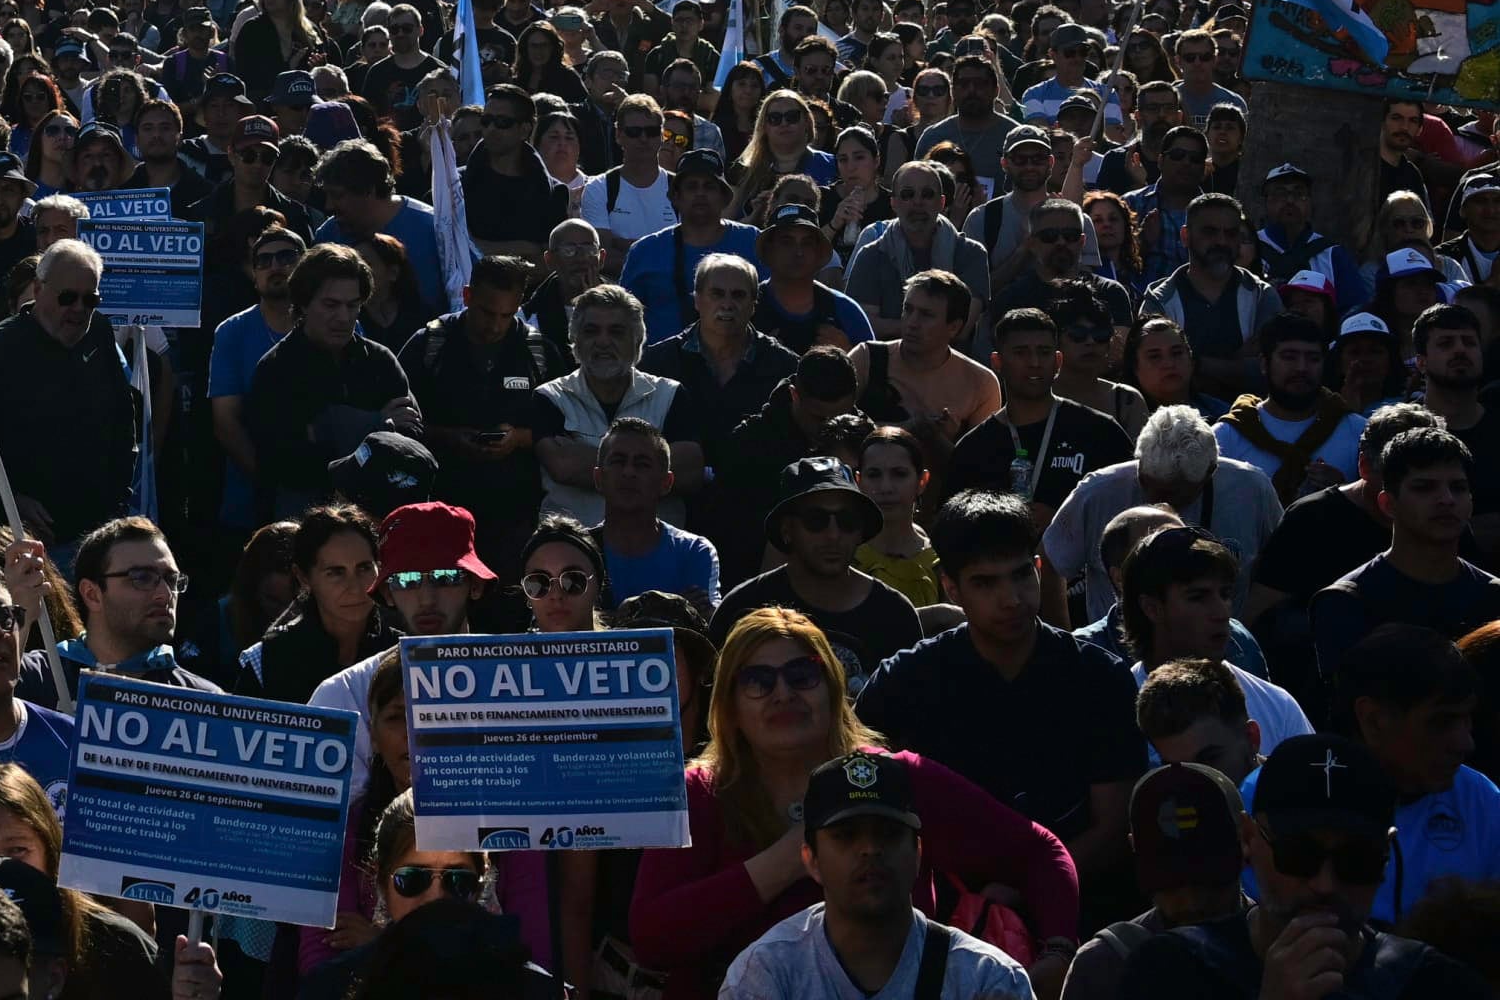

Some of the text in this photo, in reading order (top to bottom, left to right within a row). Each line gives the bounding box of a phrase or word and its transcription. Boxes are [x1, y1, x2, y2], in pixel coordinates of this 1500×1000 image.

[93, 200, 168, 216] AL VETO
[80, 233, 201, 252] NO AL VETO
[133, 315, 149, 325] 40
[1051, 453, 1084, 476] ATUNQ
[437, 641, 640, 658] PARO NACIONAL UNIVERSITARIO
[409, 658, 672, 699] NO AL VETO
[115, 691, 322, 729] PARO NACIONAL UNIVERSITARIO
[419, 705, 666, 721] DE LA LEY DE FINANCIAMIENTO UNIVERSITARIO
[80, 704, 348, 773] NO AL VETO
[483, 731, 598, 744] Jueves 26 de septiembre
[415, 752, 536, 763] Paro total de actividades
[553, 750, 676, 762] Banderazo y volanteada
[83, 752, 336, 796] DE LA LEY DE FINANCIAMIENTO UNIVERSITARIO
[424, 766, 438, 775] sin
[440, 765, 504, 775] concurrencia
[514, 765, 528, 774] los
[433, 776, 521, 788] lugares de trabajo
[145, 785, 263, 809] Jueves 26 de septiembre
[848, 790, 880, 799] BRASIL
[72, 793, 196, 820] Paro total de actividades
[79, 806, 93, 816] sin
[95, 810, 161, 828] concurrencia
[171, 820, 186, 831] los
[213, 816, 337, 841] Banderazo y volanteada
[86, 820, 177, 842] lugares de trabajo
[540, 827, 573, 848] 40
[576, 826, 605, 836] AÑOS
[184, 887, 252, 909] 40 AÑOS
